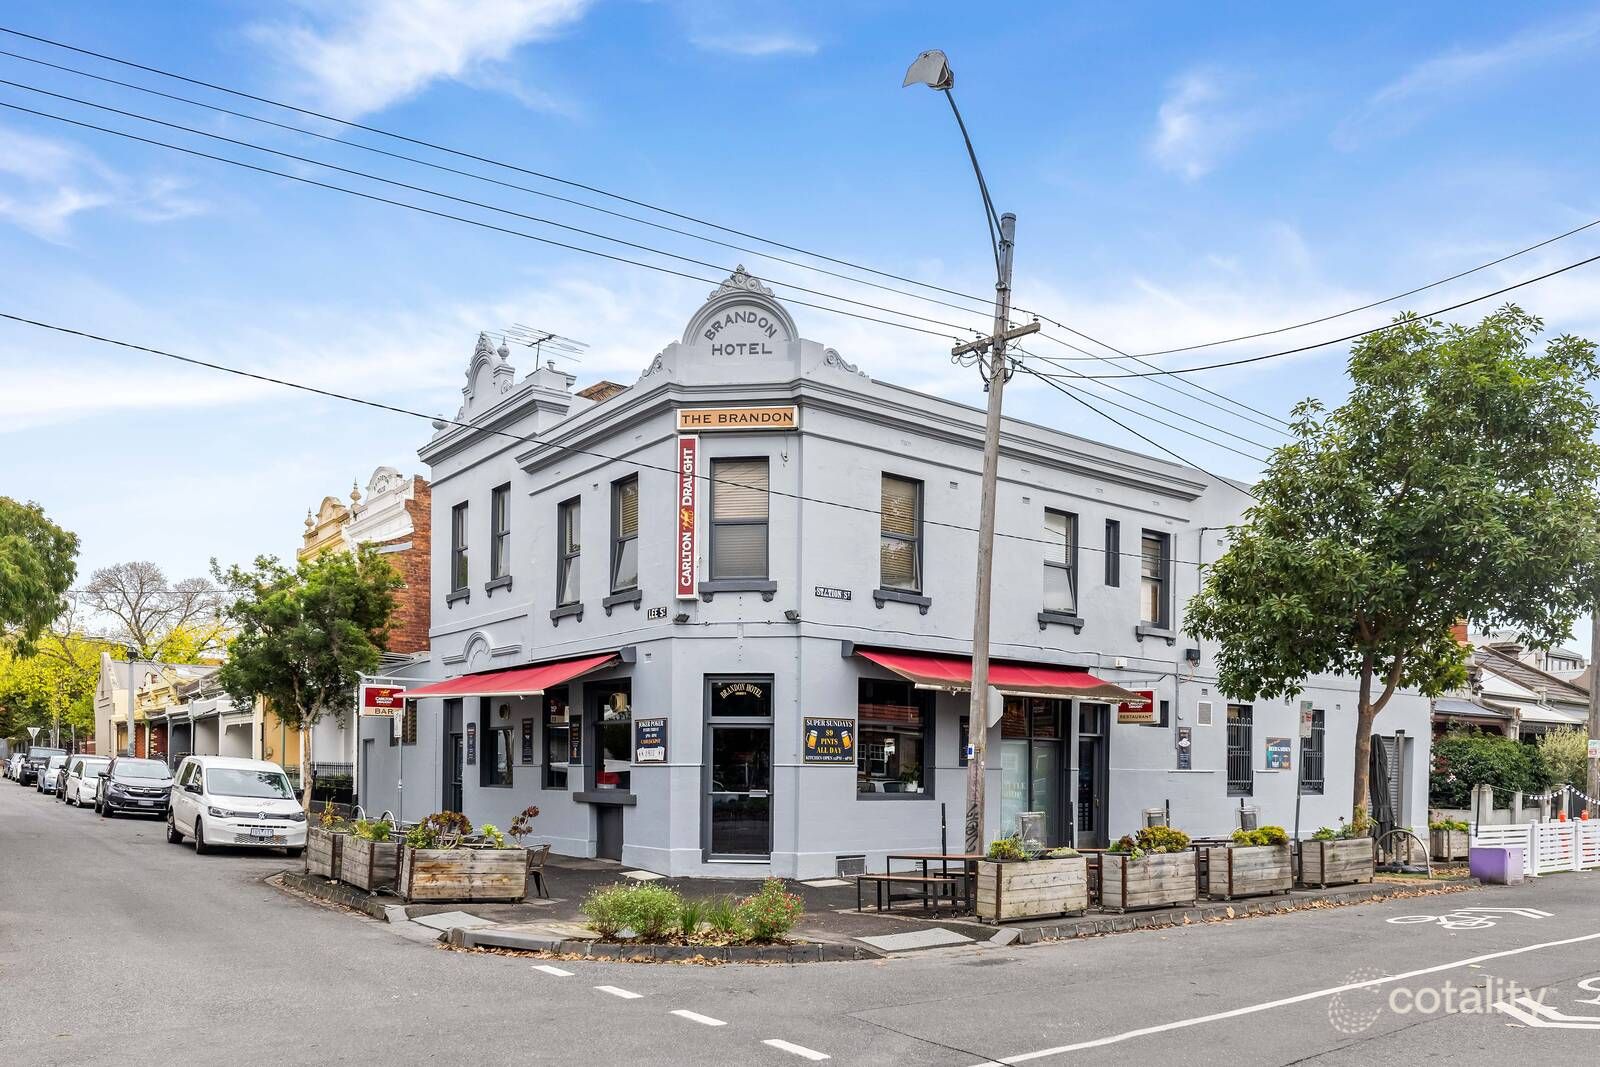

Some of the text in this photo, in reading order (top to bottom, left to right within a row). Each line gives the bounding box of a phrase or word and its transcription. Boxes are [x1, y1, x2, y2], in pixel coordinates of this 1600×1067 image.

[704, 311, 777, 341] BRANDON
[712, 343, 772, 356] HOTEL
[682, 412, 793, 424] THE BRANDON
[681, 448, 693, 587] CARLTON DRAUGHT
[817, 588, 842, 598] STATION
[649, 608, 658, 618] LEE
[720, 683, 762, 699] BRANDON HOTEL
